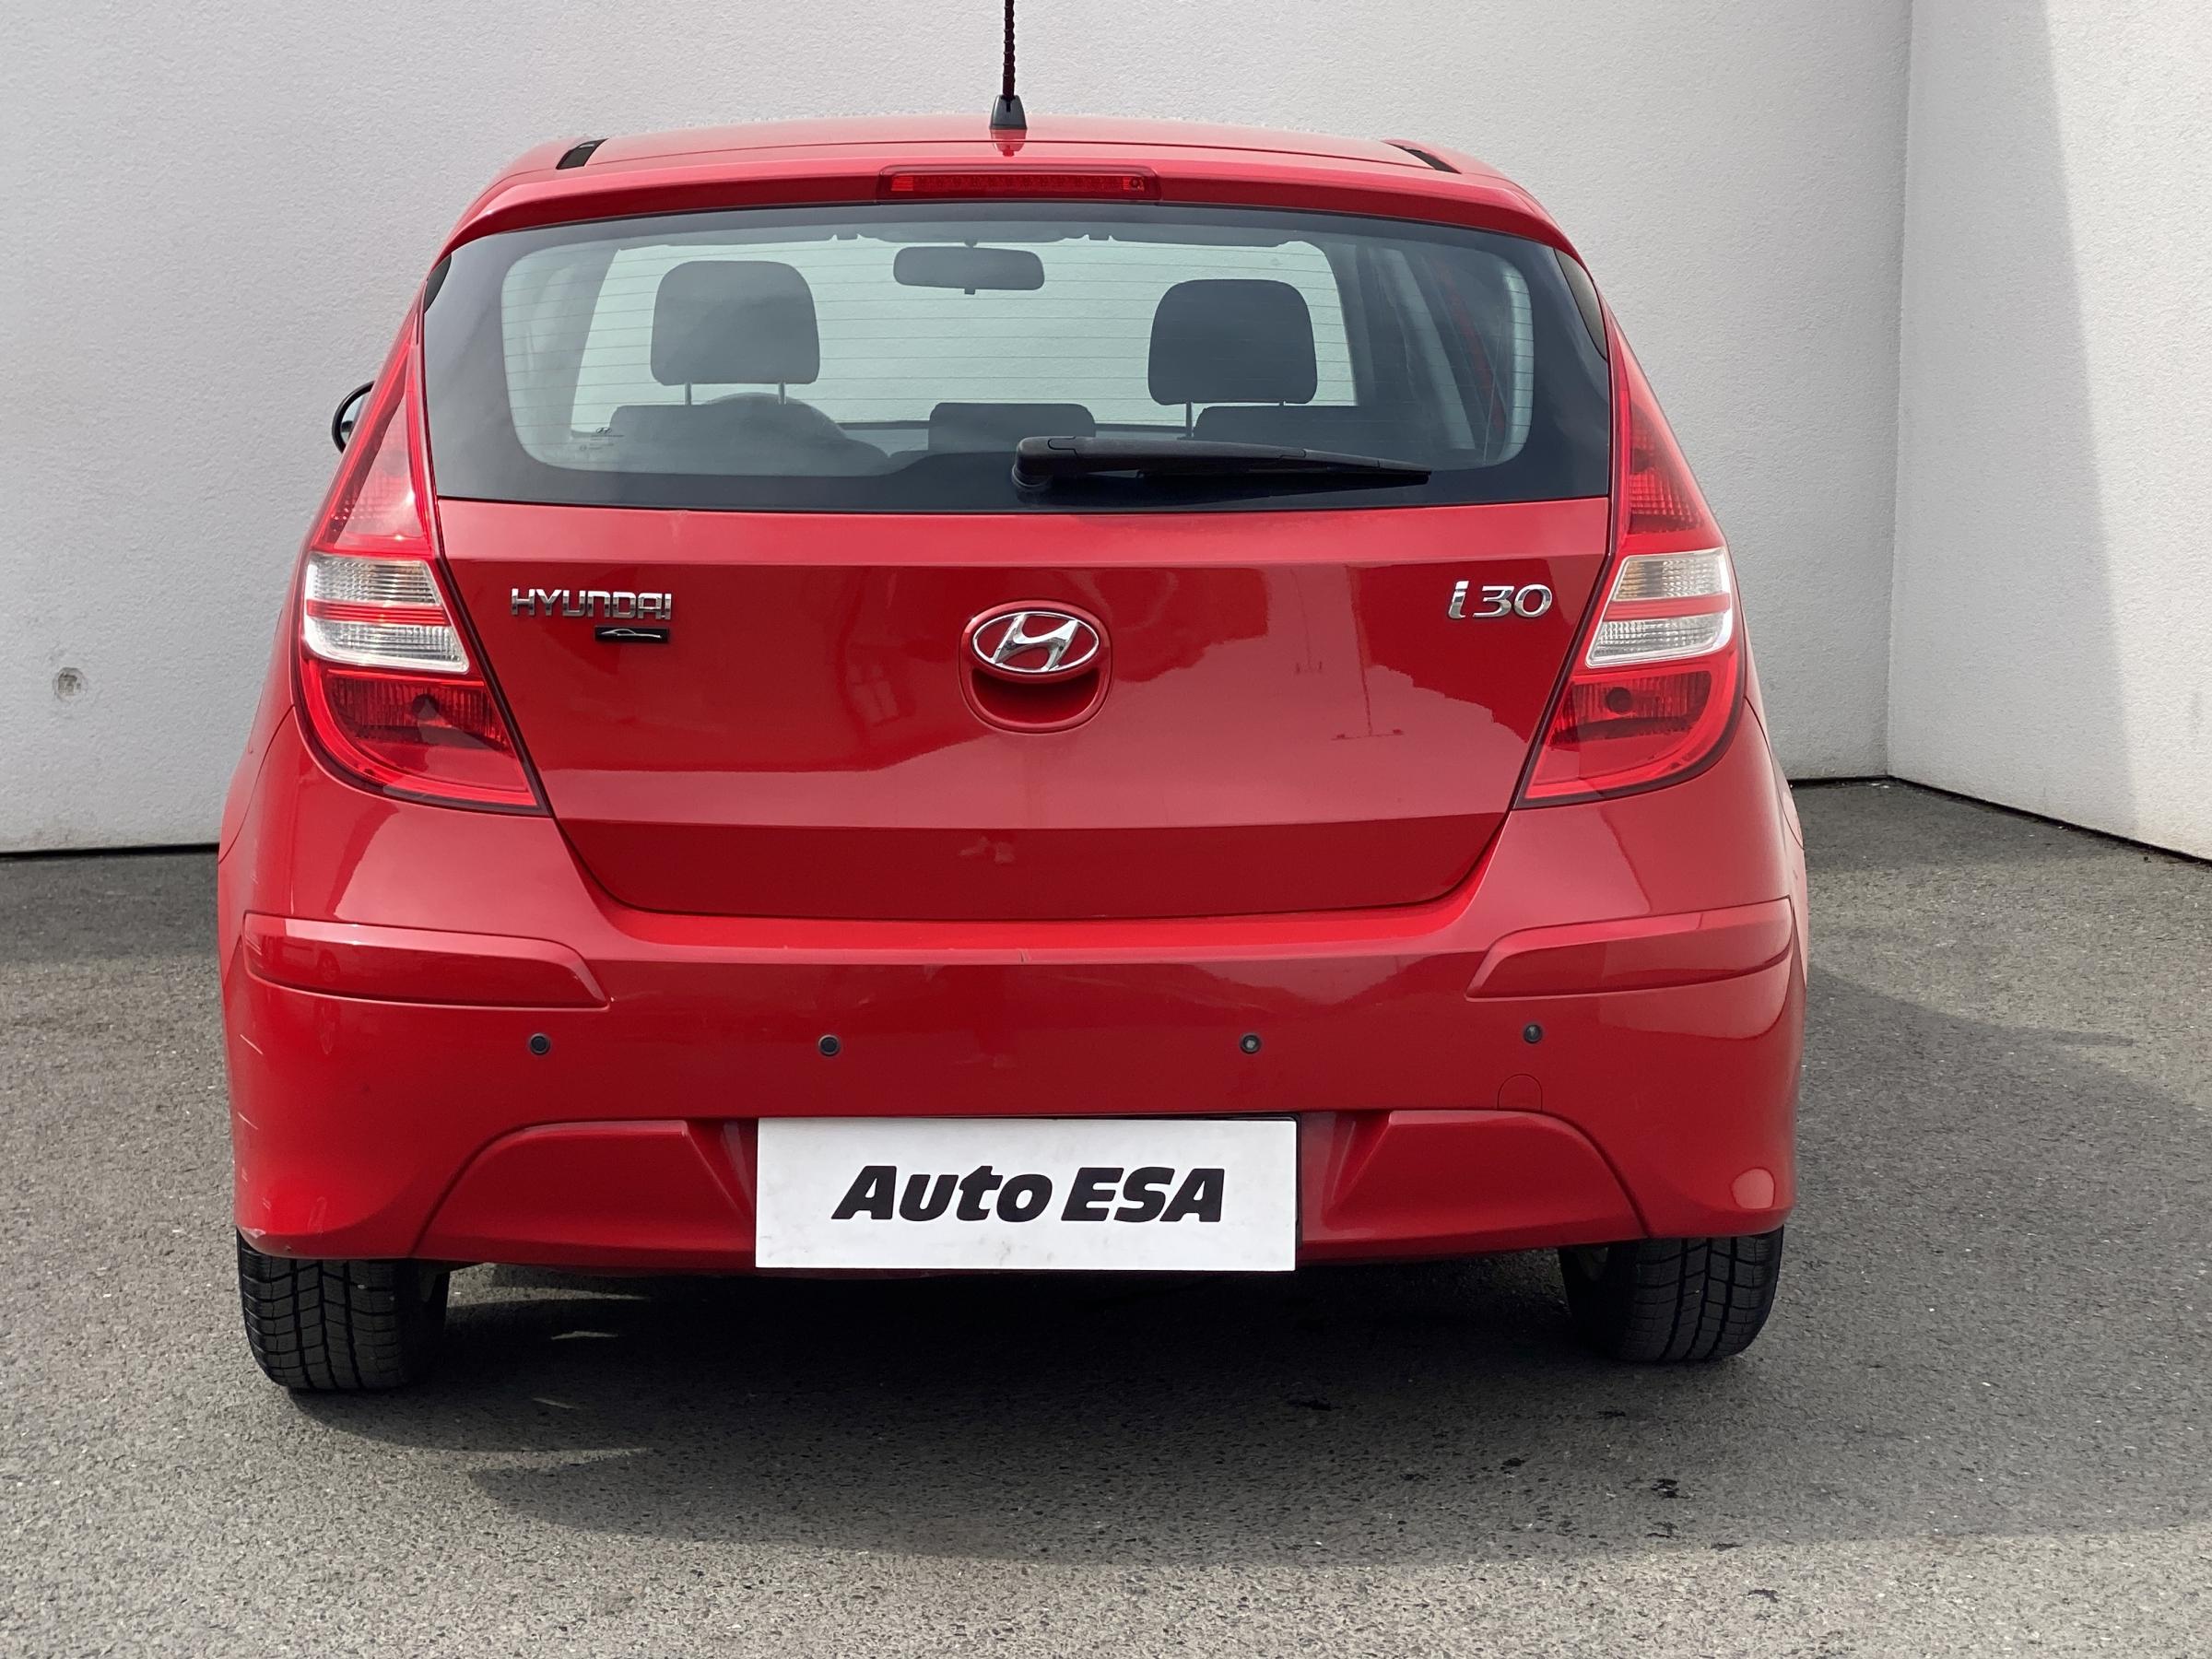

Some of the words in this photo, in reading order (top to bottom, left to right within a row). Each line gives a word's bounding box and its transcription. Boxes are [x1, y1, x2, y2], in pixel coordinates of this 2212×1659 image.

[511, 587, 673, 620] HYUNDAI
[830, 1165, 1053, 1222] Auto
[1060, 1166, 1226, 1223] ESA
